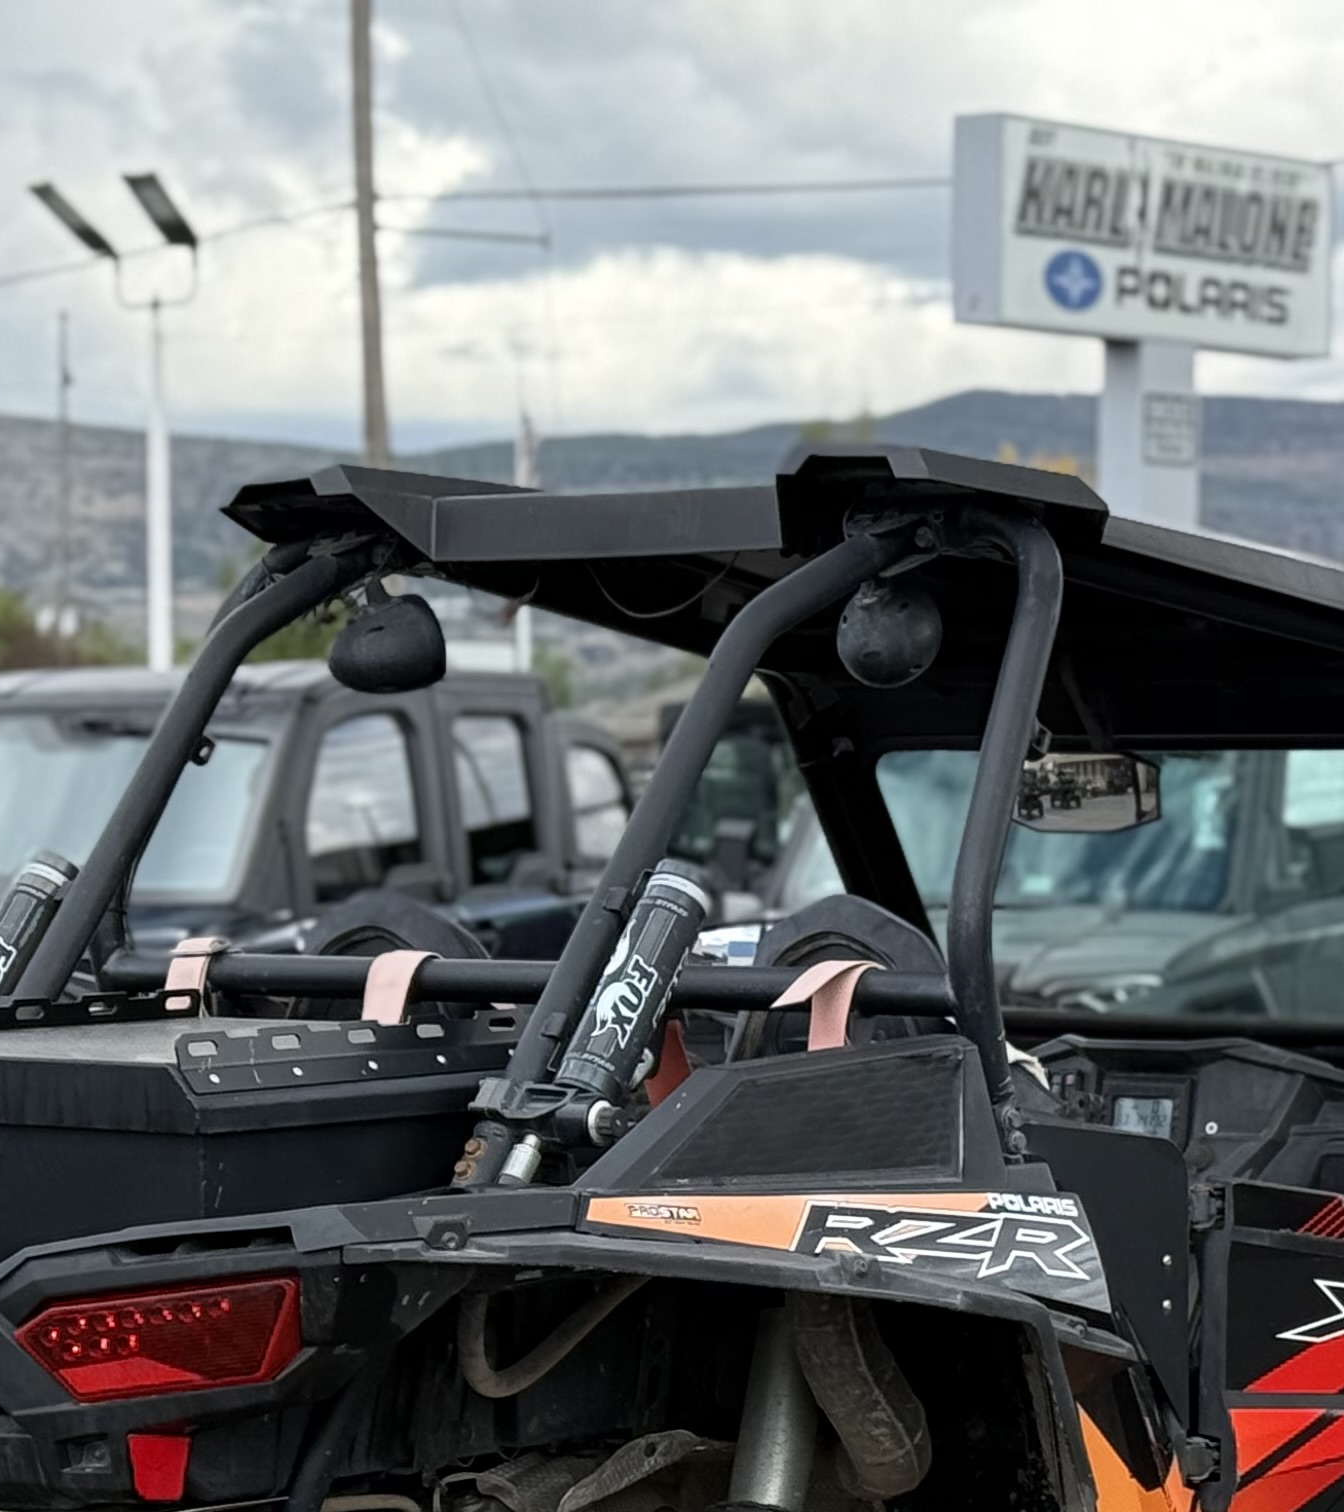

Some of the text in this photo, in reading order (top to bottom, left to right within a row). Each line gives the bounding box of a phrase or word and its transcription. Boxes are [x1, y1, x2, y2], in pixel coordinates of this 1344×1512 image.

[1154, 175, 1320, 265] MALONE
[1114, 264, 1291, 327] POLARIS
[591, 954, 658, 1049] FOX
[626, 1204, 700, 1221] PROSTAR
[789, 1198, 1091, 1280] RZR
[986, 1192, 1079, 1217] POLARIS
